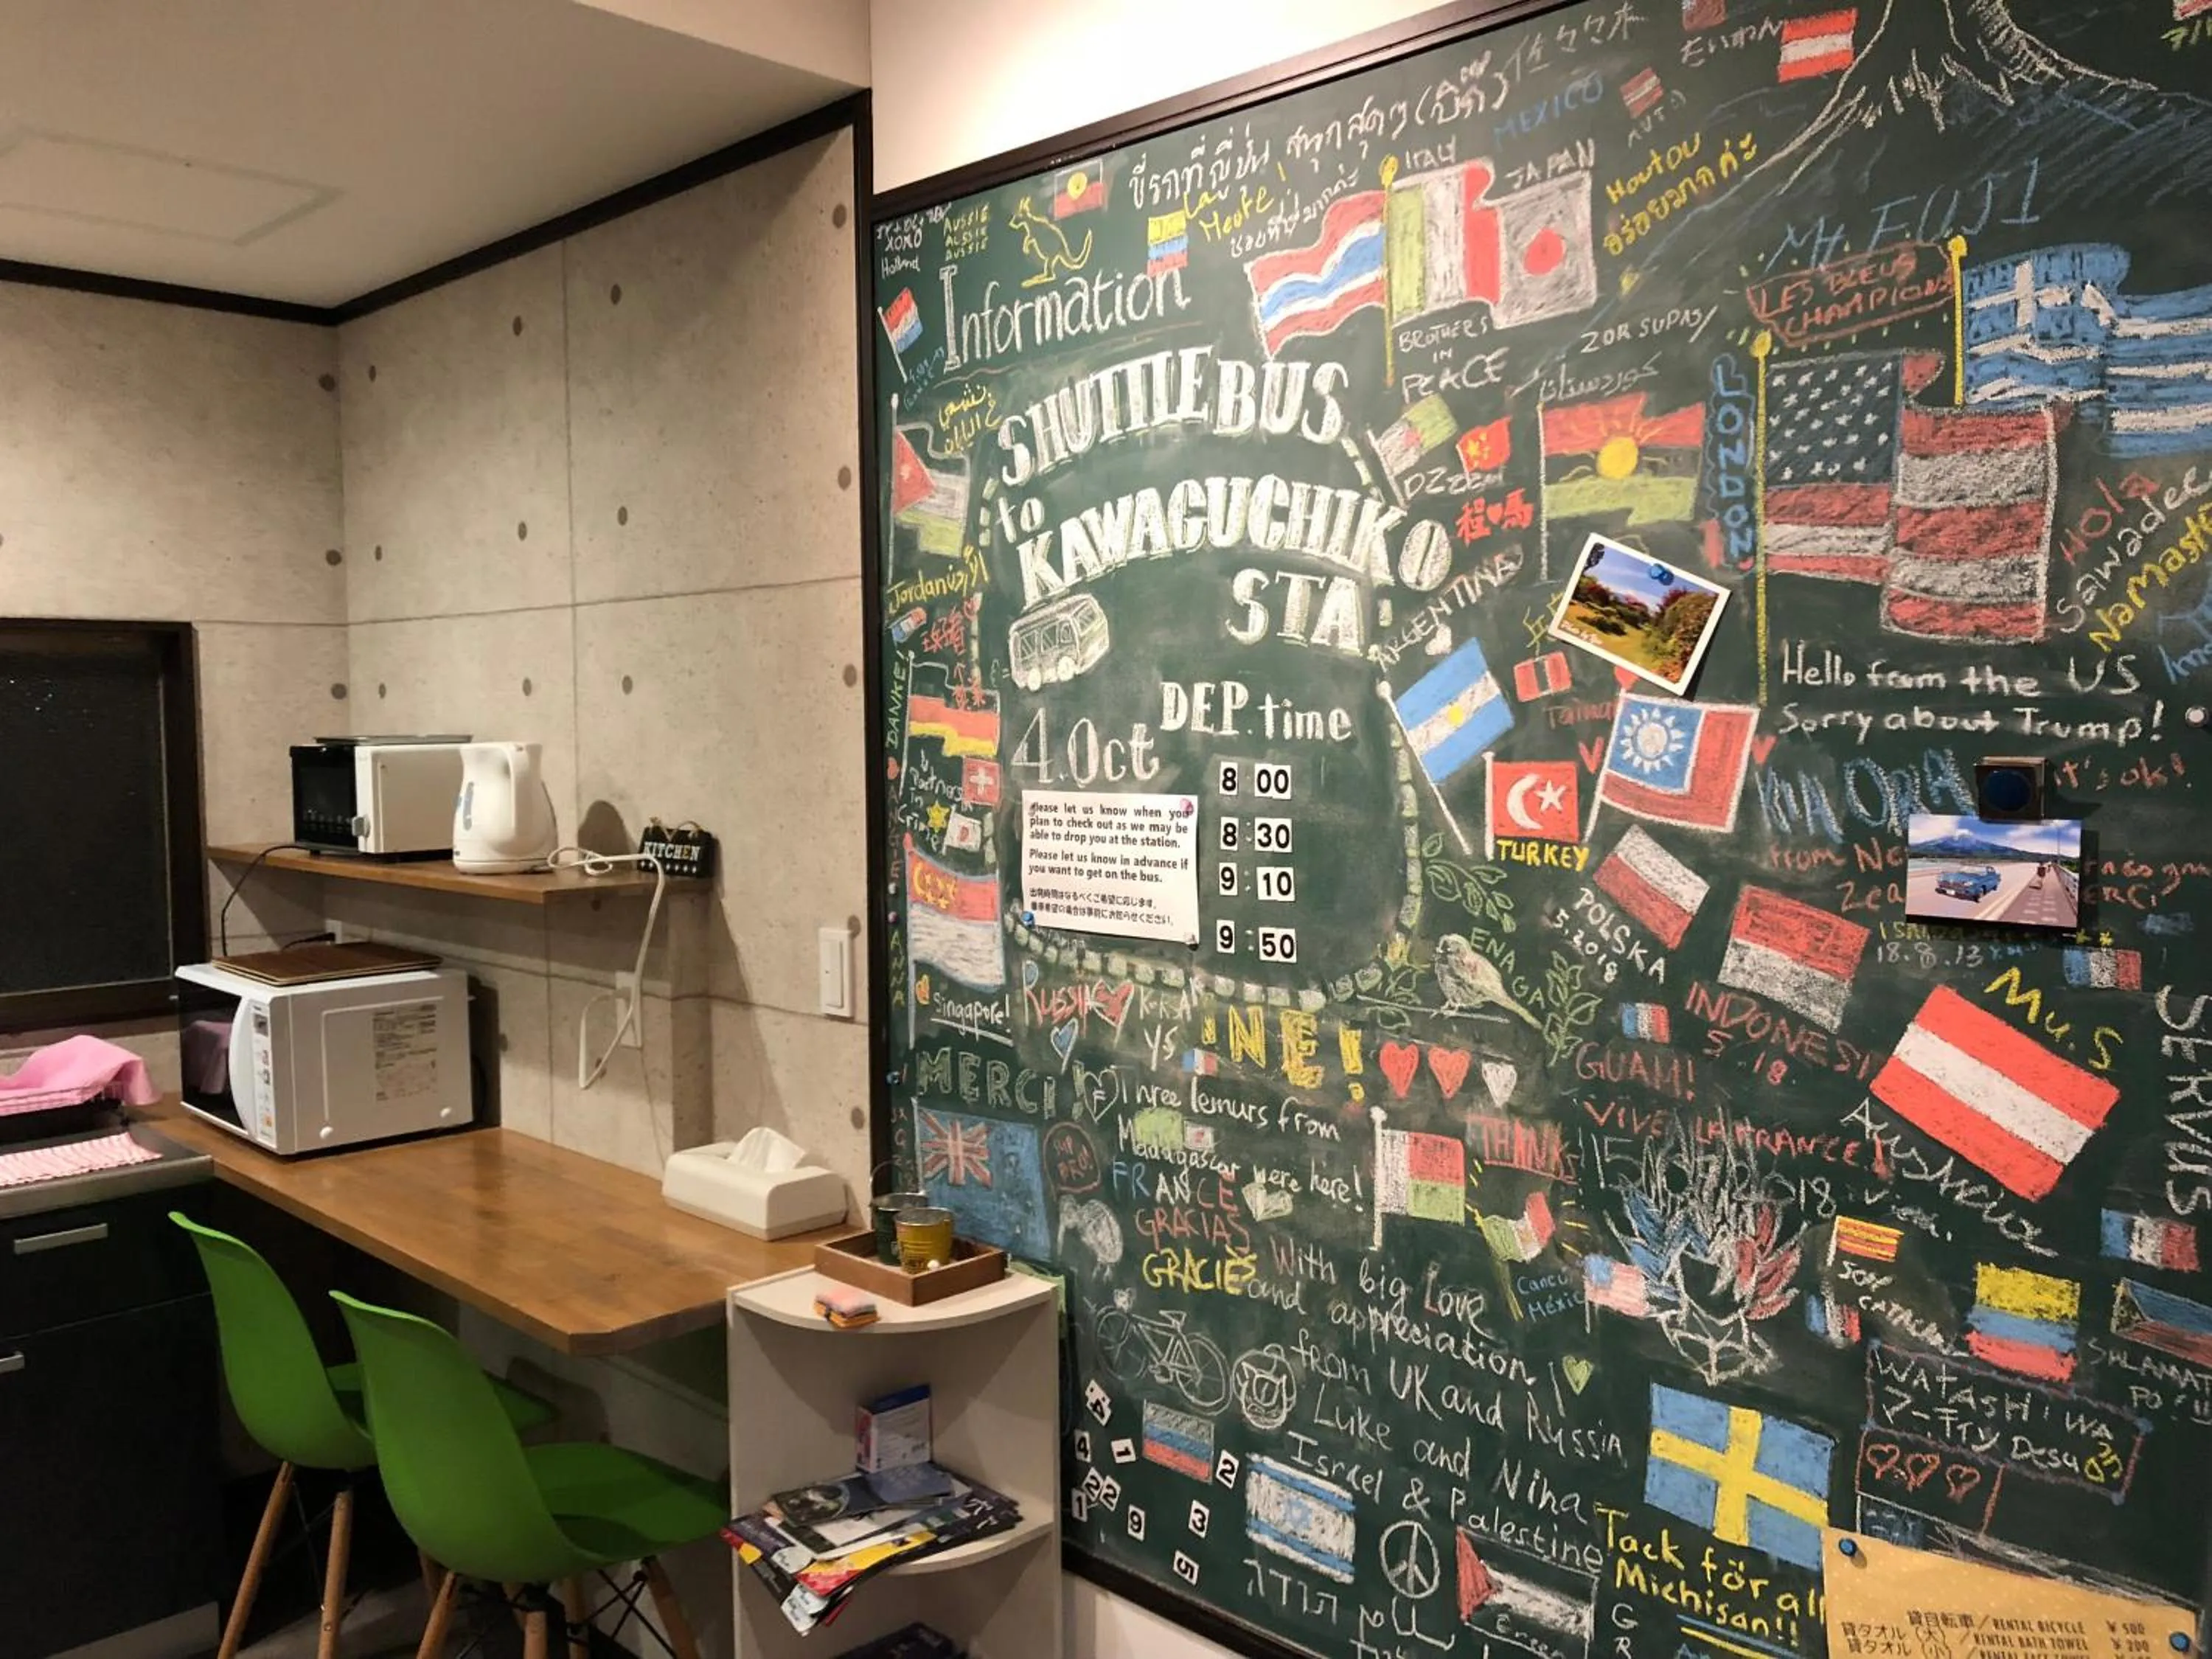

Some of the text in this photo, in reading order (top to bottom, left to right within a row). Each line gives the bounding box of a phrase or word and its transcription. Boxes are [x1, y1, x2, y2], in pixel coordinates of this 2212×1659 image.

[1493, 72, 1602, 151] MEXICO
[1405, 136, 1457, 170] ITALY
[1504, 138, 1594, 190] JAPAN
[939, 265, 1191, 373] Information
[1581, 324, 1630, 352] ZOR
[1433, 349, 1453, 361] IN
[997, 345, 1214, 487] SHUTTLE
[1213, 361, 1349, 444] BUS
[1712, 363, 1753, 558] LONDON
[996, 497, 1045, 543] to
[1017, 473, 1453, 613] KAWAGUCHIKO
[1226, 568, 1365, 658] STA
[1781, 639, 2142, 698] Hello from the US
[1257, 693, 1352, 742] time
[1778, 700, 2163, 747] Sorry about Trump!
[1030, 817, 1049, 828] plan
[1053, 818, 1062, 827] to
[1067, 818, 1093, 829] check
[1097, 820, 1113, 830] out
[1149, 824, 1171, 835] may
[1175, 823, 1188, 833] be
[1064, 803, 1077, 814] let
[1082, 806, 1093, 815] us
[1100, 804, 1127, 816] know
[1134, 806, 1161, 818] when
[644, 842, 700, 861] KITCHEN
[1029, 849, 1188, 869] Please let us know in advance if
[1030, 830, 1180, 848] able to drop you at the station.
[1497, 838, 1590, 872] TURKEY
[1028, 863, 1162, 882] you want to get on the bus.
[1571, 886, 1666, 985] POLSKA
[933, 992, 1012, 1041] Singapore!
[1191, 1077, 1267, 1128] lemurs
[1279, 1096, 1340, 1141] from
[1583, 1100, 1668, 1138] VIVE
[1117, 1113, 1242, 1182] Madagascar
[1111, 1161, 1238, 1211] FRANCE
[1253, 1159, 1363, 1212] were here!
[1134, 1207, 1251, 1253] GRACIAS
[1270, 1235, 1337, 1284] With
[1358, 1258, 1412, 1324] big
[1247, 1276, 1537, 1388] and appreciation
[1390, 1356, 1443, 1422] UK
[1440, 1385, 1507, 1435] and
[1313, 1382, 1582, 1518] Luke and Nina
[2065, 1411, 2114, 1441] WA
[1085, 1475, 1100, 1495] 2
[1102, 1485, 1116, 1506] 2
[1220, 1459, 1234, 1484] 2
[1192, 1509, 1206, 1536] 3
[1287, 1429, 1384, 1504] Israel
[1450, 1486, 1605, 1575] Palestine
[1593, 1502, 1769, 1600] Tack för
[1993, 1618, 2035, 1632] RENTAL
[2019, 1636, 2046, 1649] BATH
[2051, 1637, 2089, 1651] TOWEL
